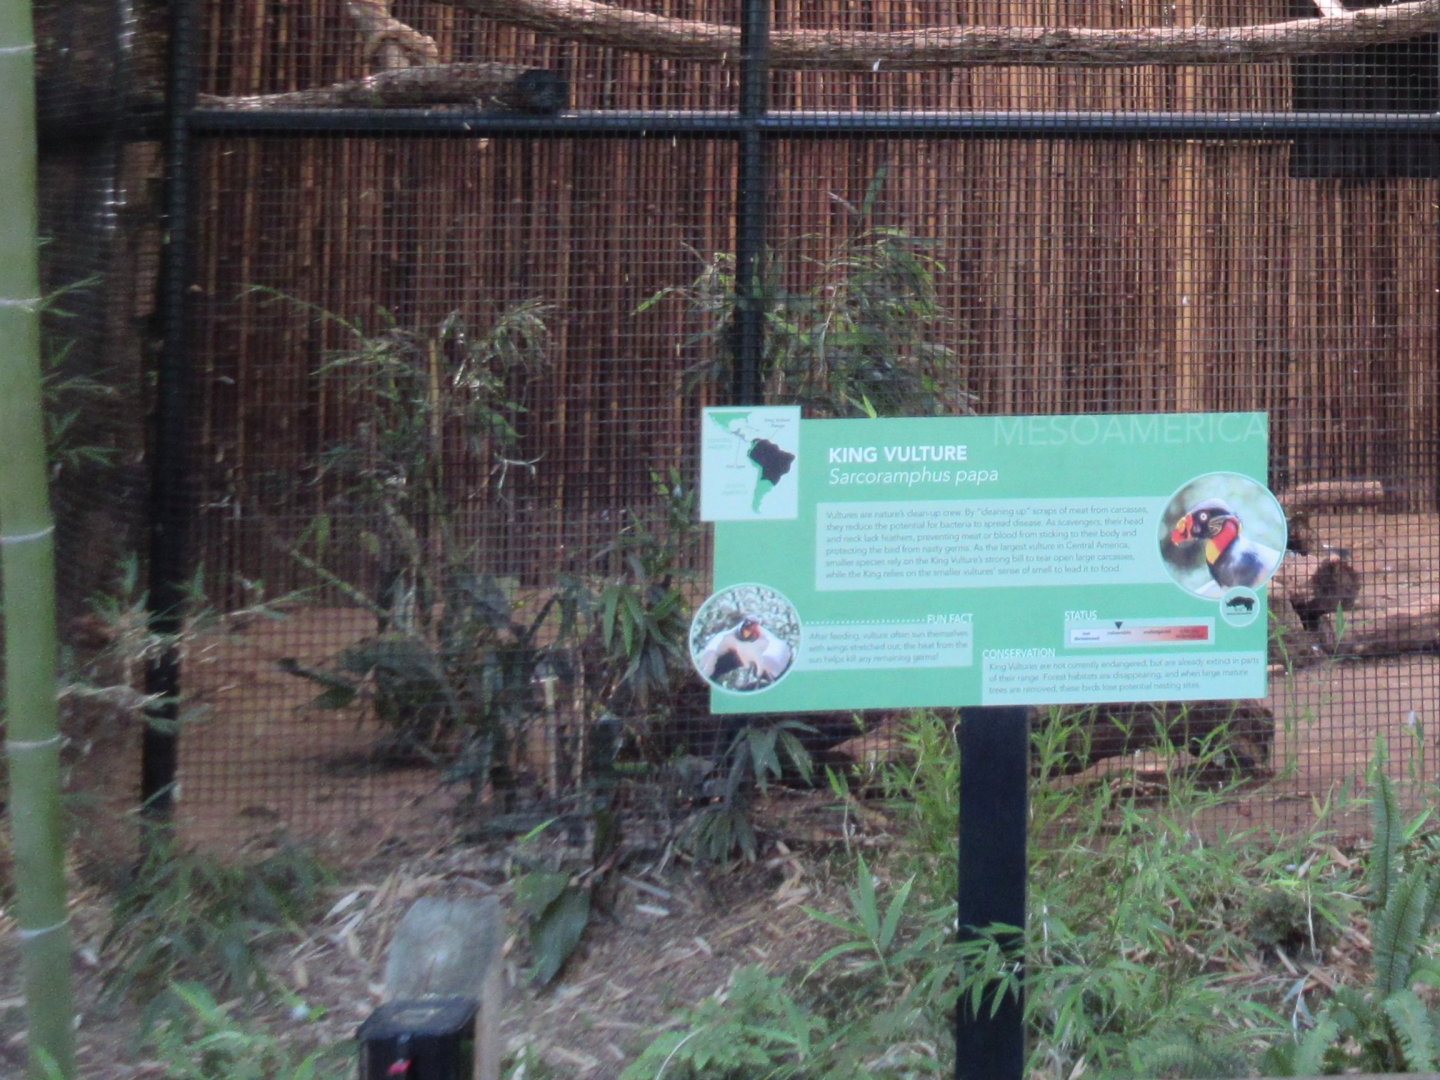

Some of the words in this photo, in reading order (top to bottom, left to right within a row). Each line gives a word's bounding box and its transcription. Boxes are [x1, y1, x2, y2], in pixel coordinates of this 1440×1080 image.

[994, 413, 1268, 446] MESOAMERICA
[829, 447, 878, 463] KING
[884, 445, 968, 461] VULTURE
[829, 466, 951, 487] Sarcoramphus
[955, 469, 999, 485] papa
[928, 614, 948, 624] FUN
[951, 613, 973, 623] FACT
[1064, 610, 1098, 620] STATUS
[982, 648, 1056, 659] CONSERVATION
